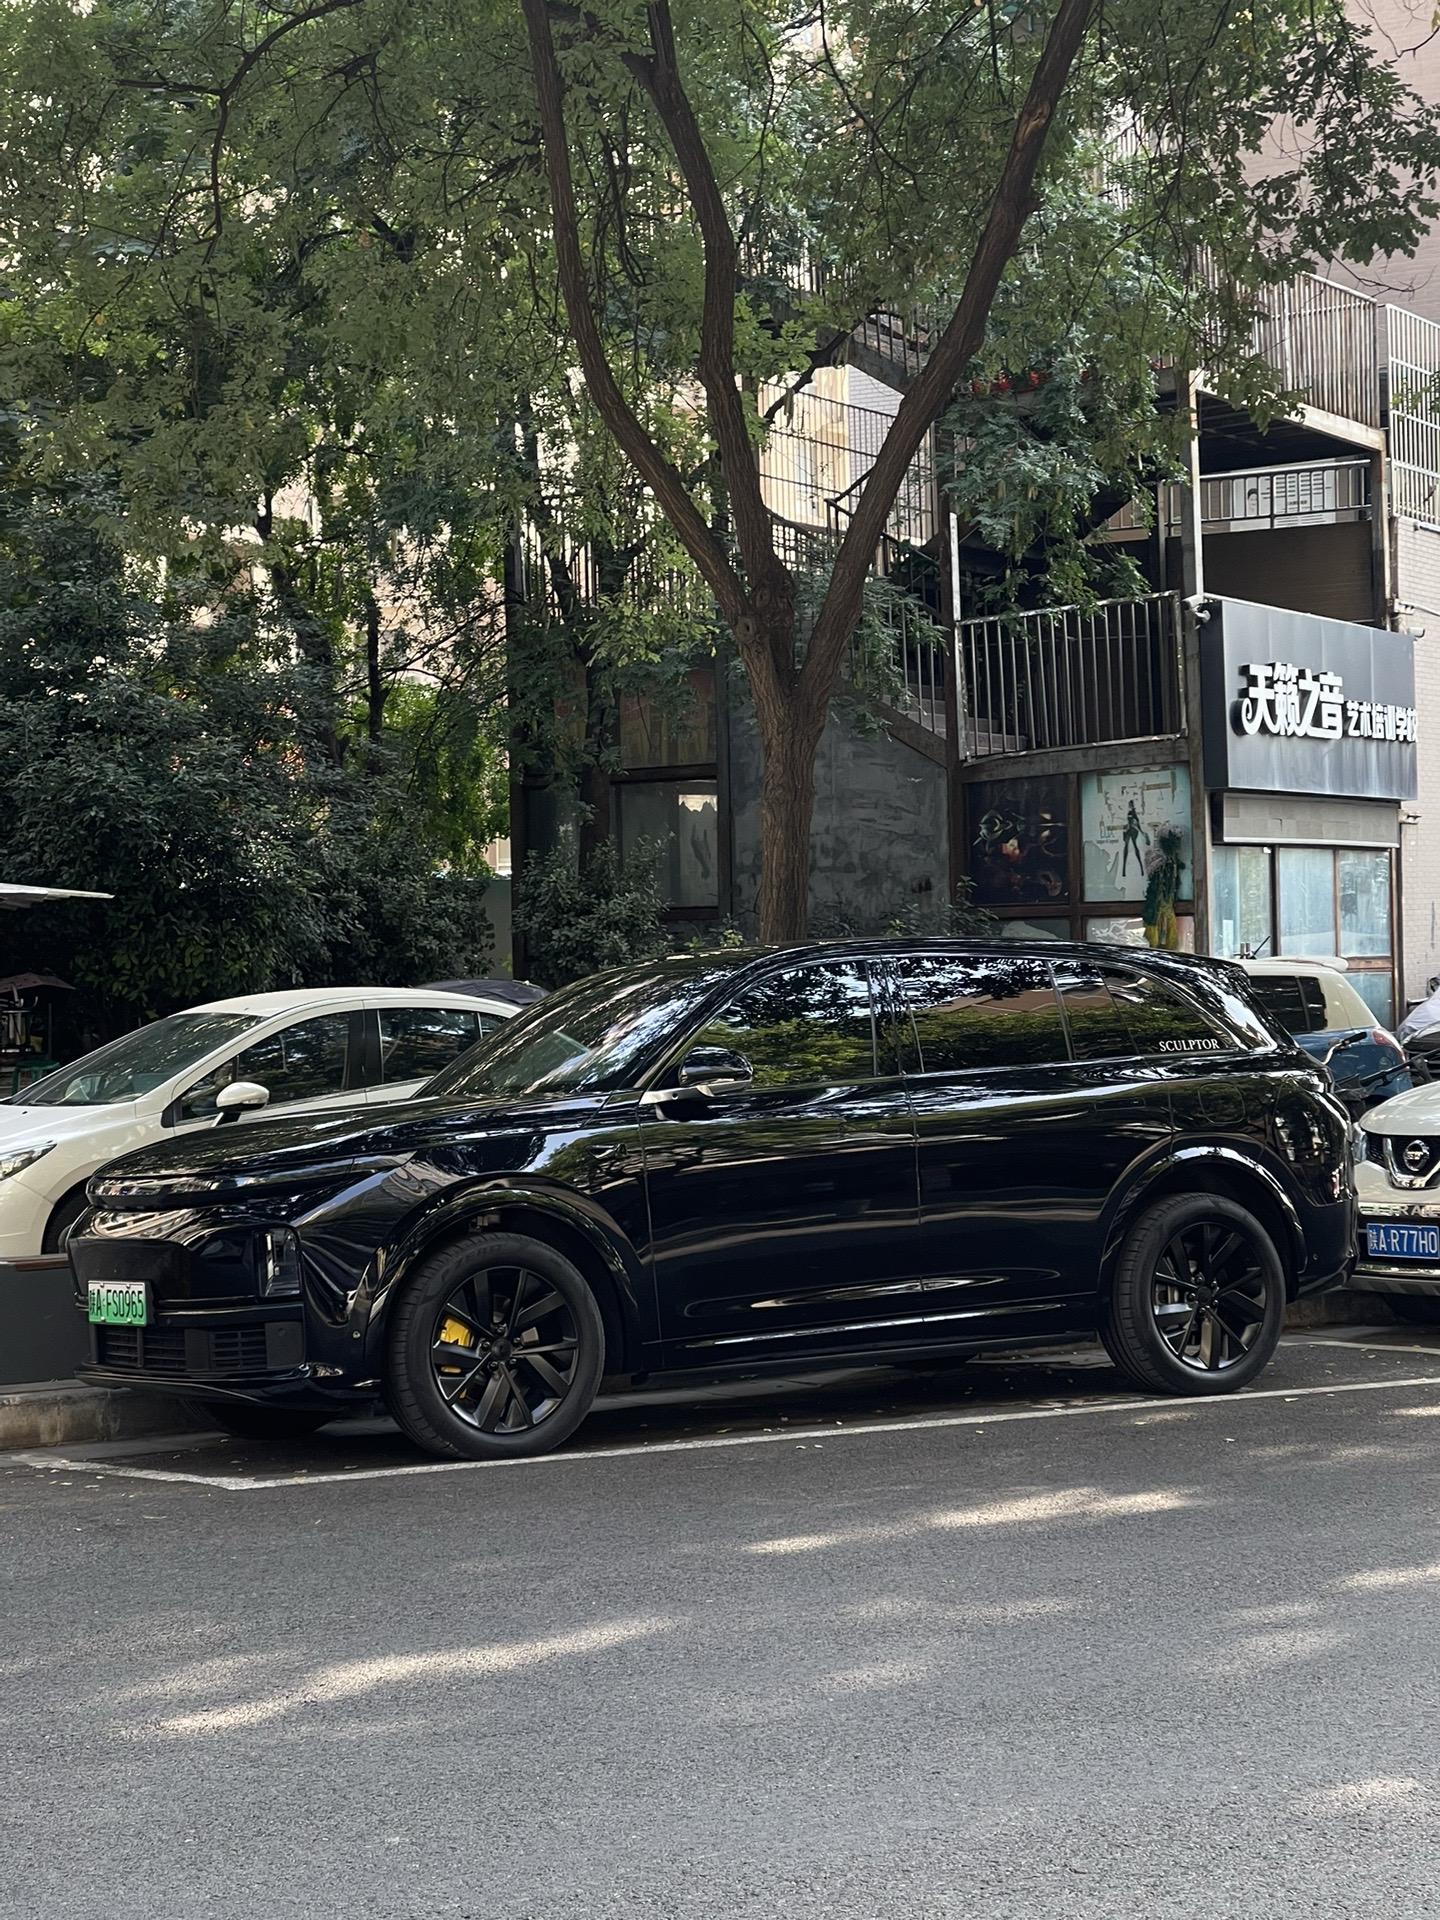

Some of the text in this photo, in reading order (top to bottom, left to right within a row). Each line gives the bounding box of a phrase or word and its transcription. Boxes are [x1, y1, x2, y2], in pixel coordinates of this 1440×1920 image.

[1242, 661, 1418, 743] 天籁之音 艺术培训学校
[1159, 1038, 1220, 1052] SCULPTOR
